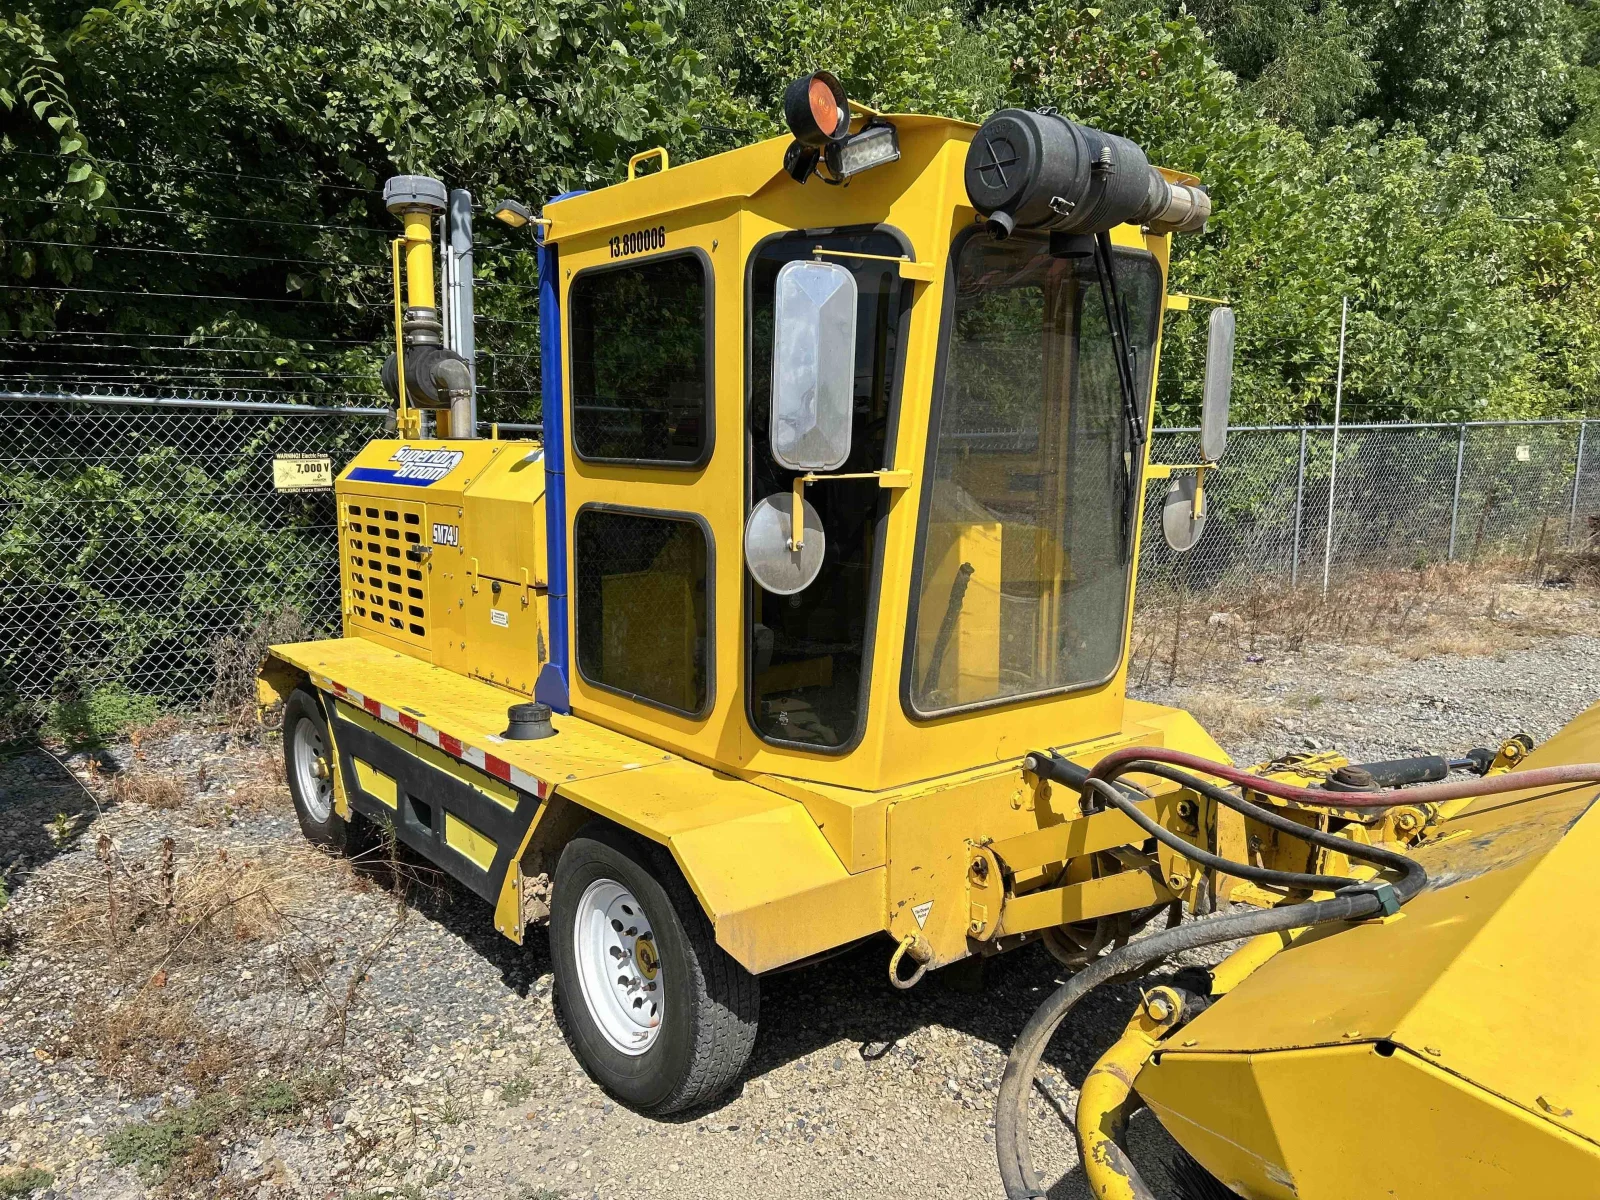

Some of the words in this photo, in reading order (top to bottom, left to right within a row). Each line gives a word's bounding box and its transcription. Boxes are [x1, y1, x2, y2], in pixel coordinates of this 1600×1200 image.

[609, 225, 665, 258] 13.800006
[389, 445, 457, 463] Superior
[296, 463, 322, 474] 7,000
[323, 463, 329, 472] V
[393, 461, 446, 480] Broom
